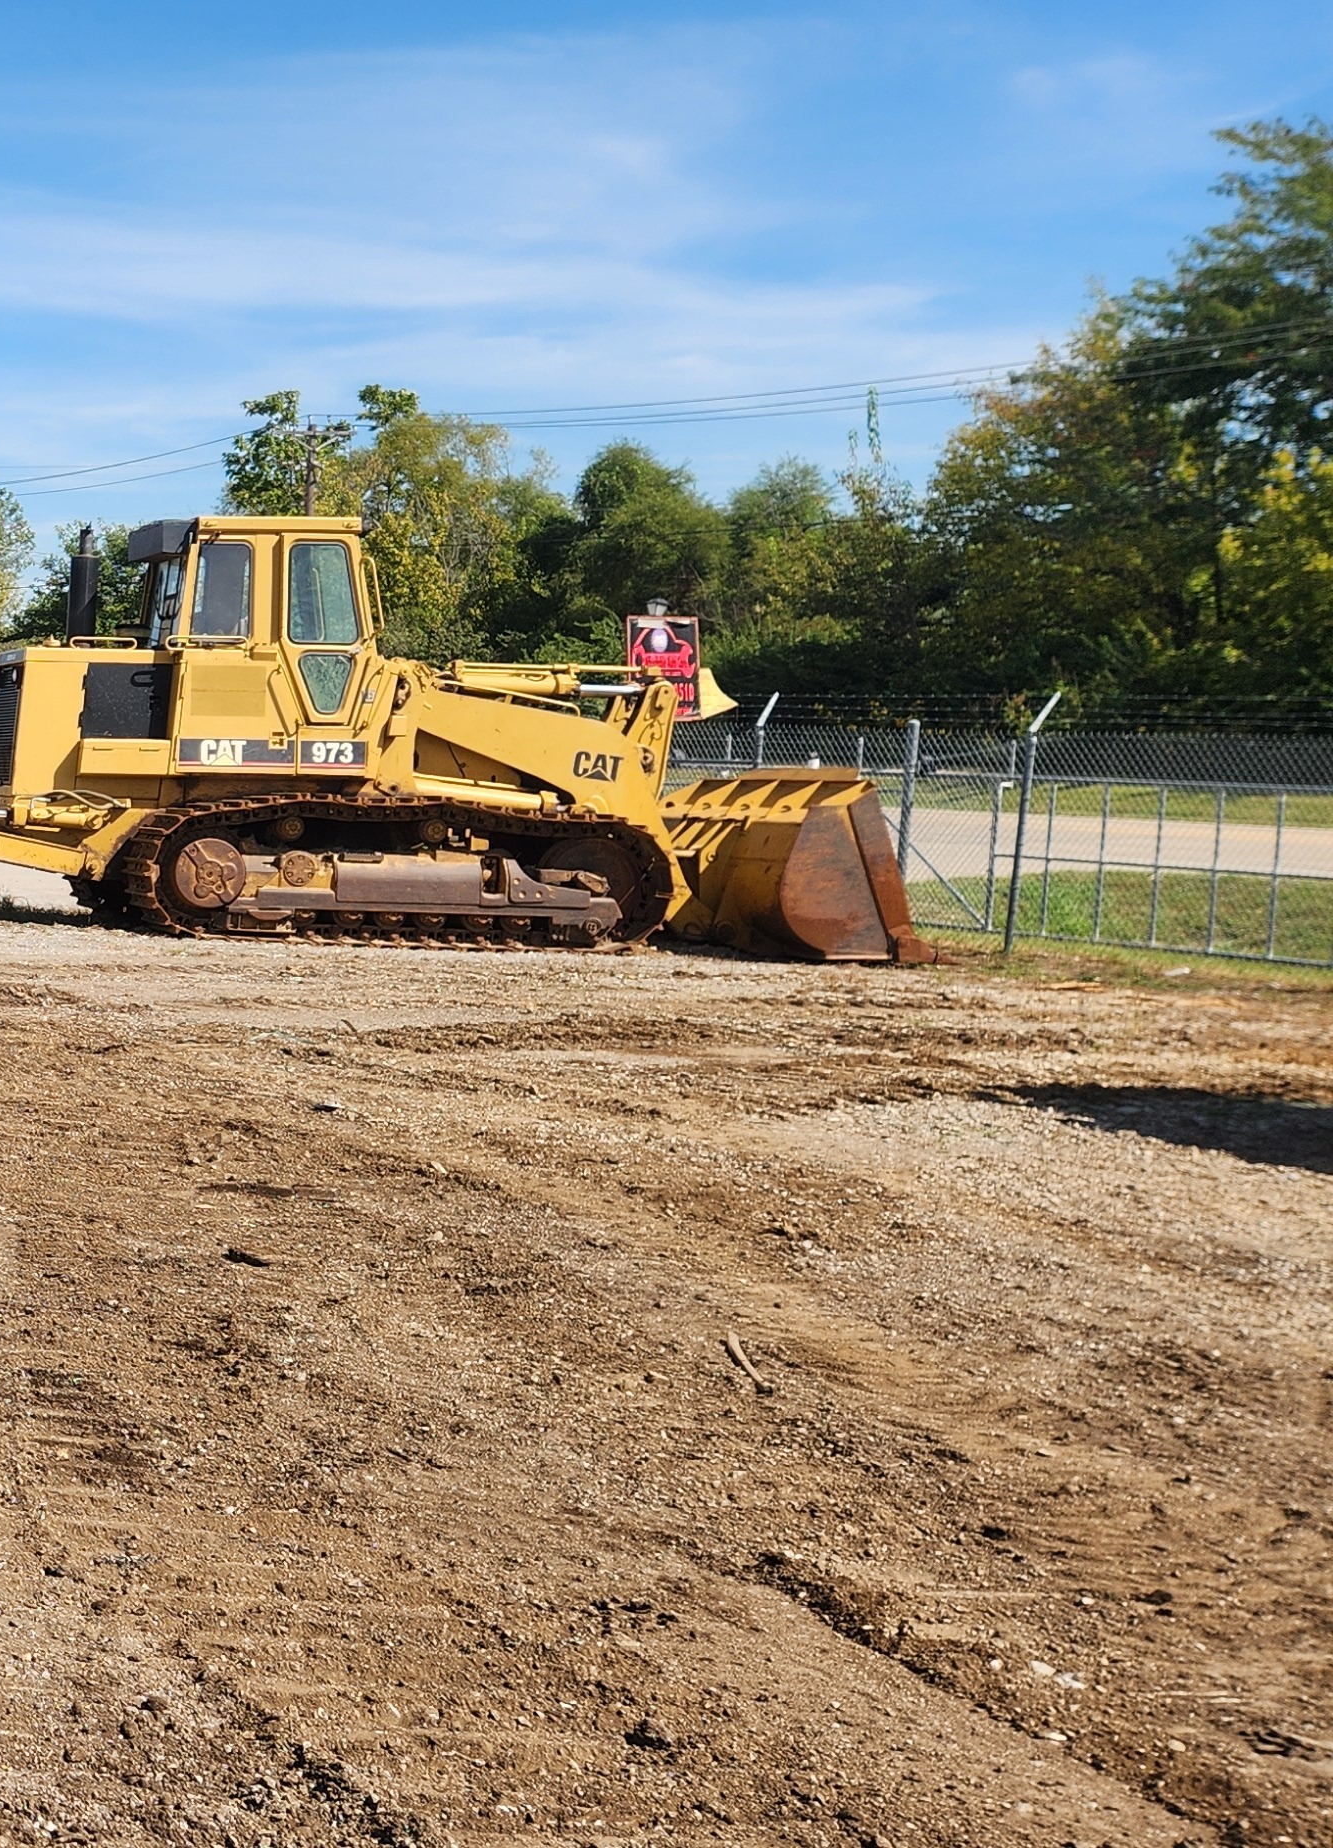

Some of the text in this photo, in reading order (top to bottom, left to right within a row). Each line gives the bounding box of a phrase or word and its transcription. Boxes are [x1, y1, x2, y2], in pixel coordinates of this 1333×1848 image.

[200, 739, 354, 766] CAT 973
[573, 751, 624, 782] CAT
